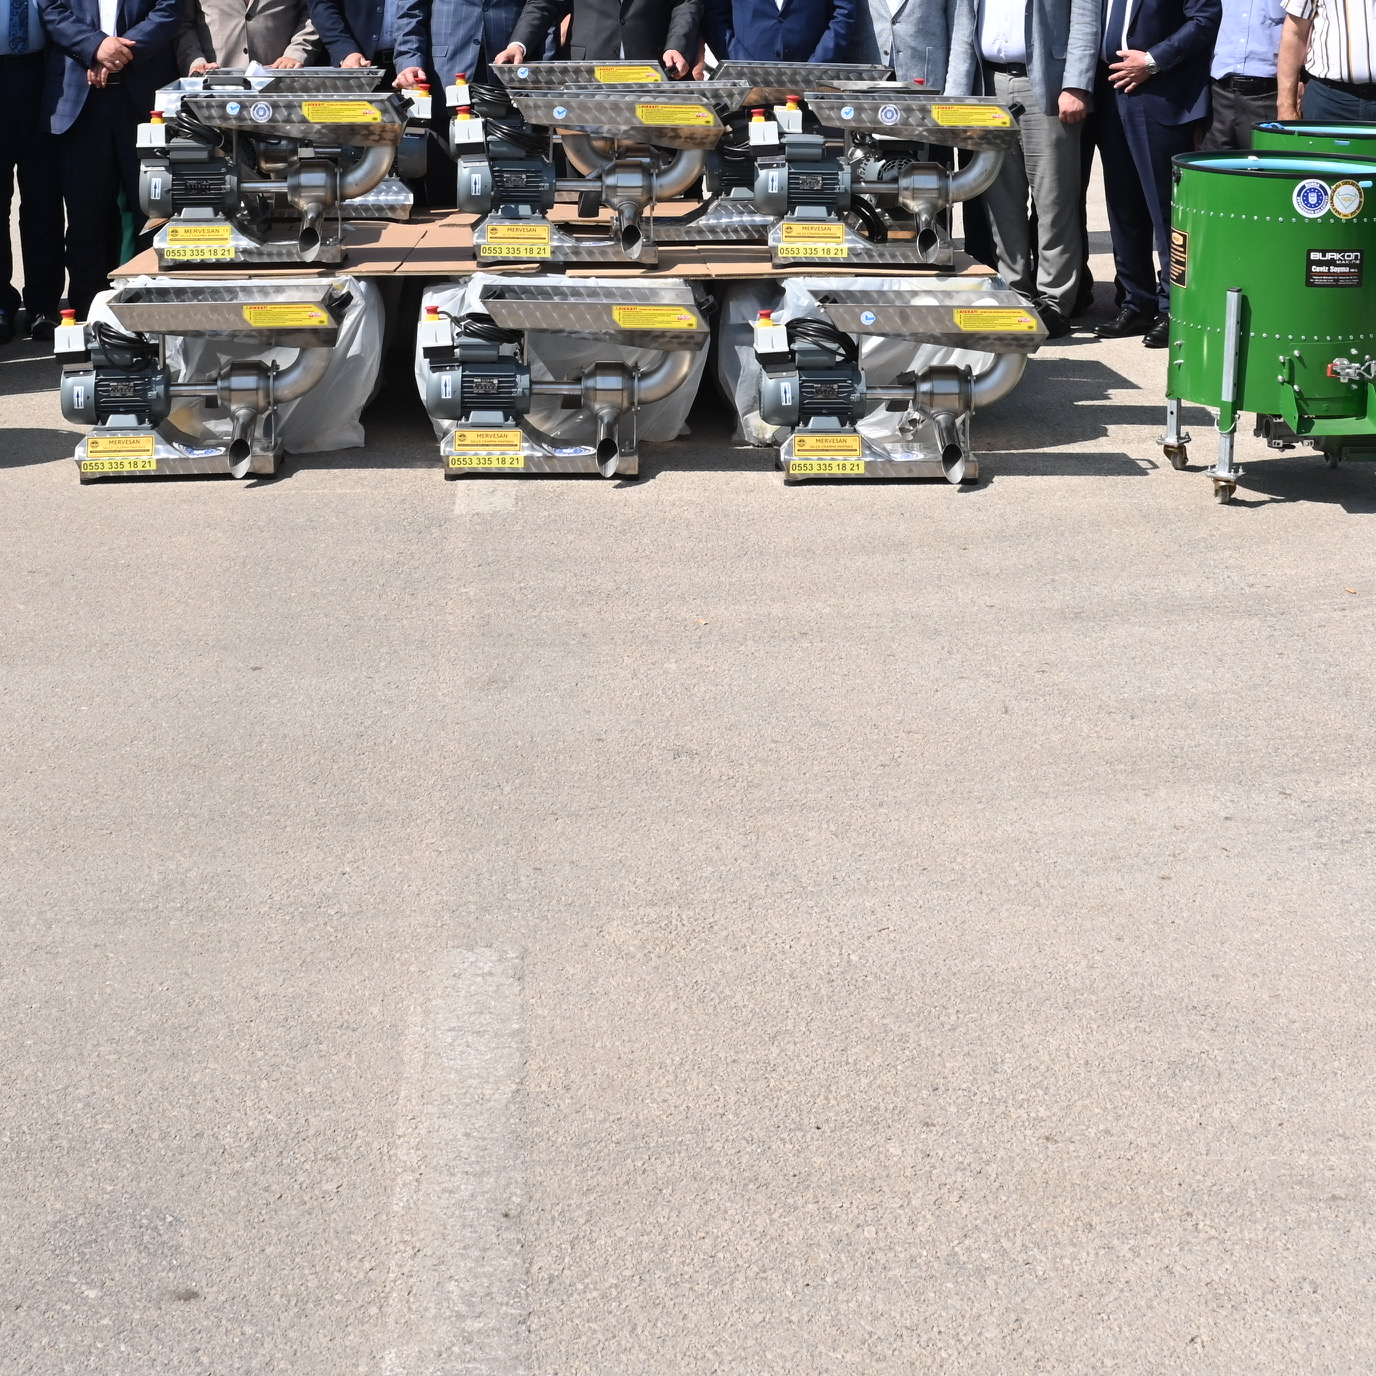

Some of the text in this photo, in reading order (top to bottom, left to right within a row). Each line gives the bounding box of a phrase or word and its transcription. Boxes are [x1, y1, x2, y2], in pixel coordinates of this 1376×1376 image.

[482, 247, 546, 255] 0553 335 18 21
[1310, 252, 1360, 260] BURKON
[83, 460, 152, 471] 0553 335 18 21
[451, 457, 519, 466] 0553 335 18 21
[791, 463, 860, 471] 0553 335 18 21
